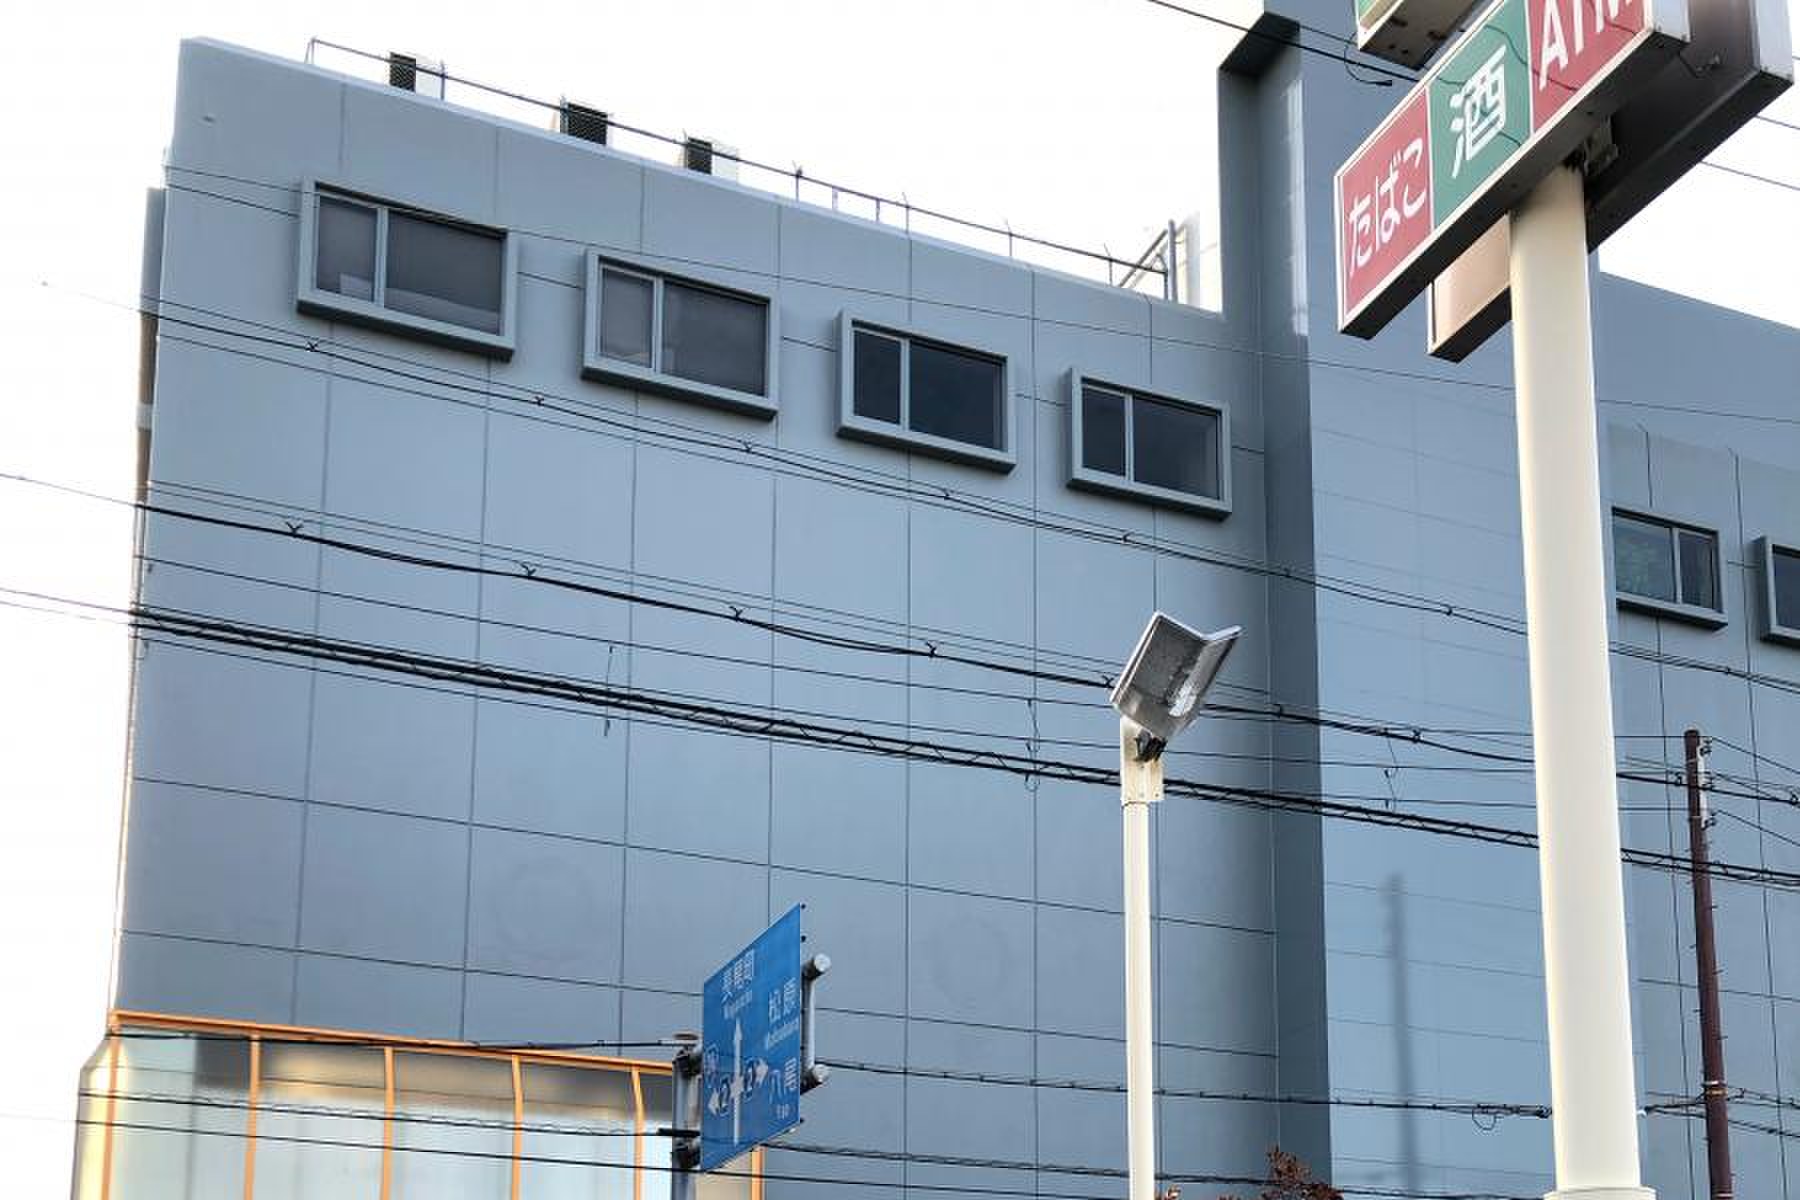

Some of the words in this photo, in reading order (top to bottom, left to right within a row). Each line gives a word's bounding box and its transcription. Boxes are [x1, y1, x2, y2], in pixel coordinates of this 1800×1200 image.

[1450, 45, 1507, 179] 酒
[1348, 137, 1427, 276] たばこ
